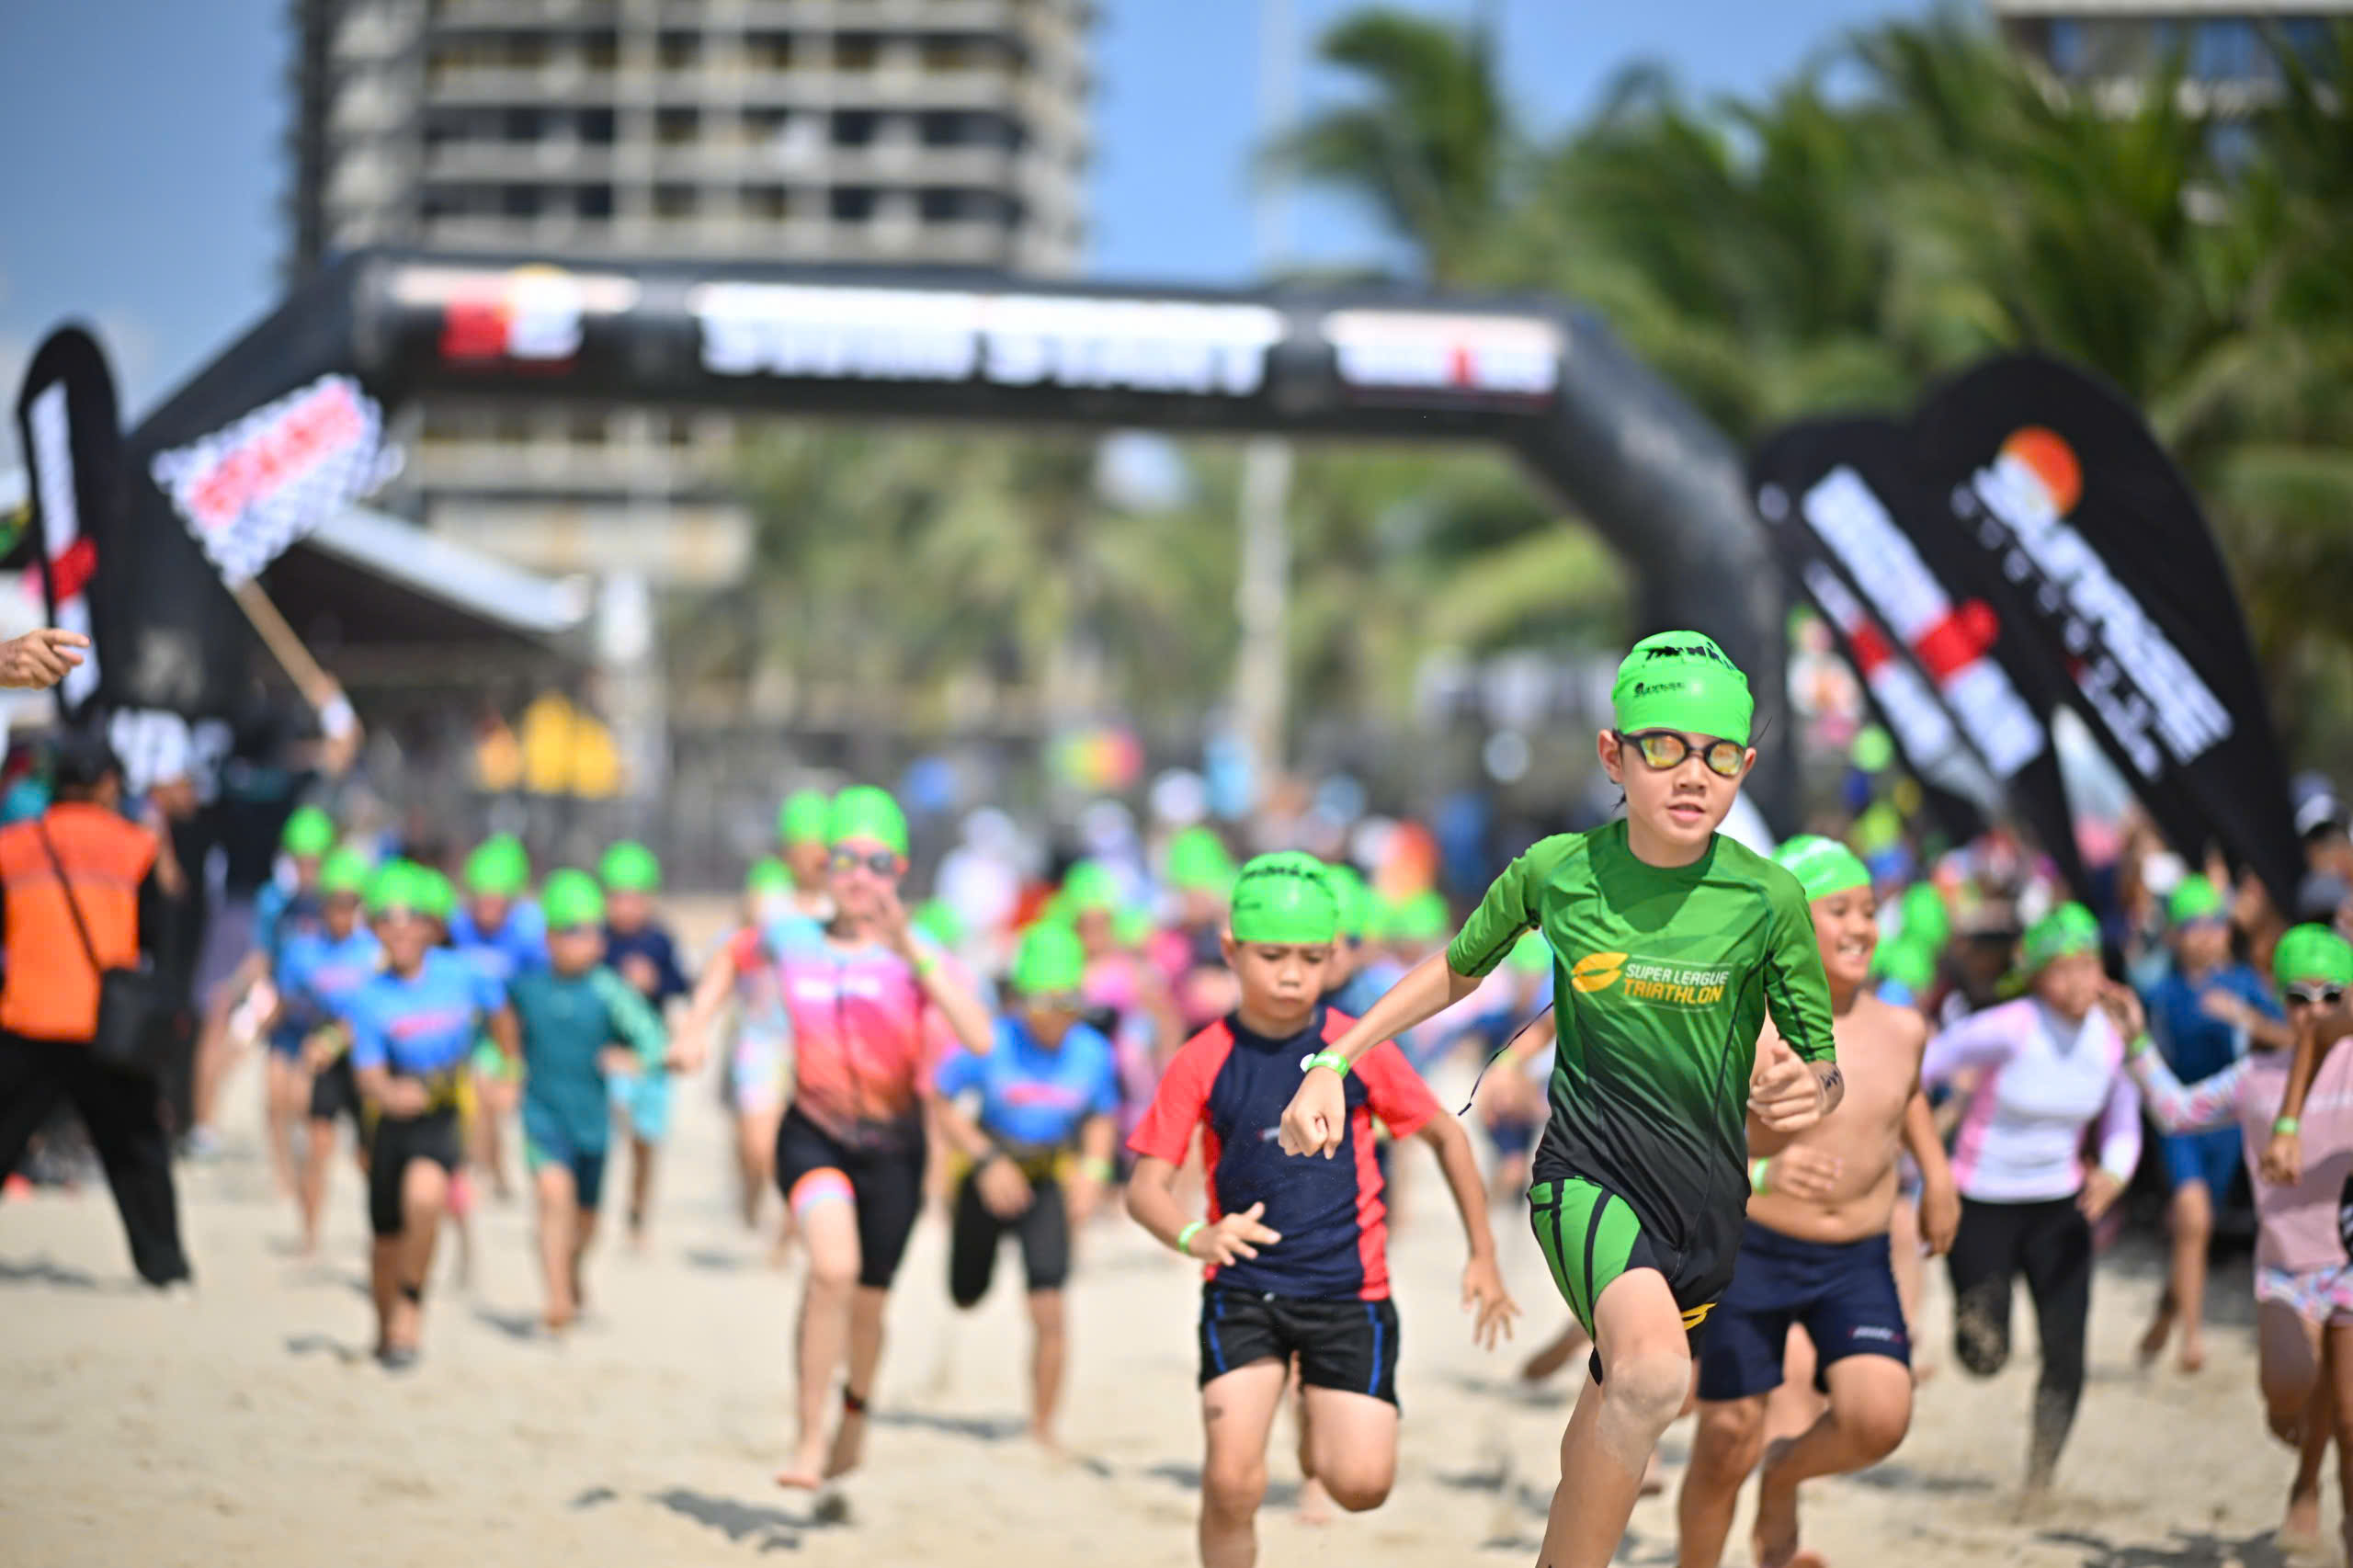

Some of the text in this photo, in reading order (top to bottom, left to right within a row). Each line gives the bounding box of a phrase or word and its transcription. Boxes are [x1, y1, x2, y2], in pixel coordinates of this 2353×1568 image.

[1626, 963, 1730, 986] SUPER LEAGUE
[1624, 978, 1724, 1004] TRIATHLON
